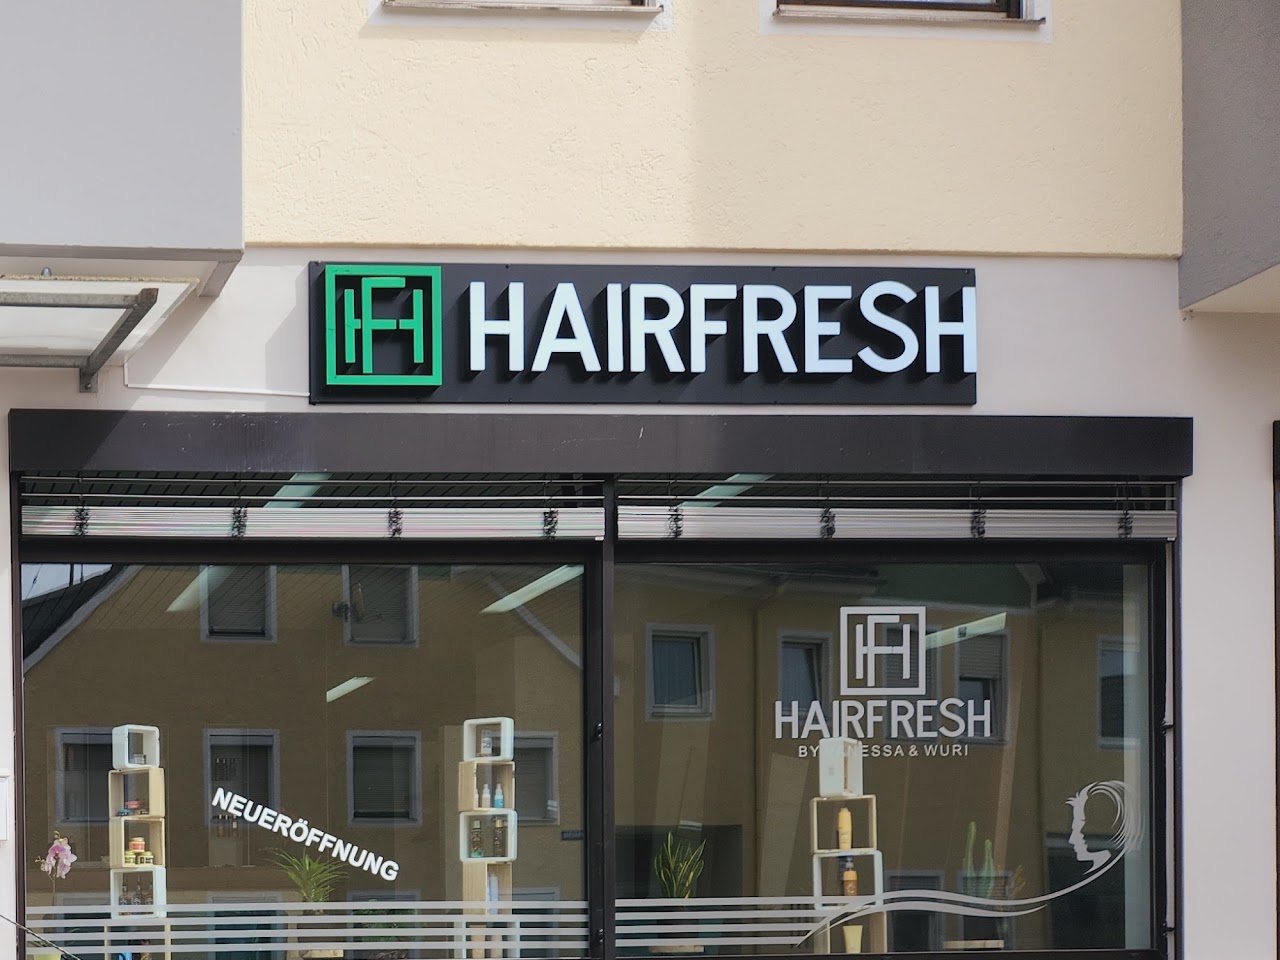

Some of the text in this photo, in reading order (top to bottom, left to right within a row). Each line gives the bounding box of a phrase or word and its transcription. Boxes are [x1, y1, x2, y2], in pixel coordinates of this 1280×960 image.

[469, 280, 976, 374] HAIRFRESH
[775, 698, 991, 738] HAIRFRESH
[798, 745, 820, 758] BY
[908, 745, 919, 757] &
[924, 744, 969, 757] WURI
[211, 787, 400, 881] NEUERÖFFNUNG
